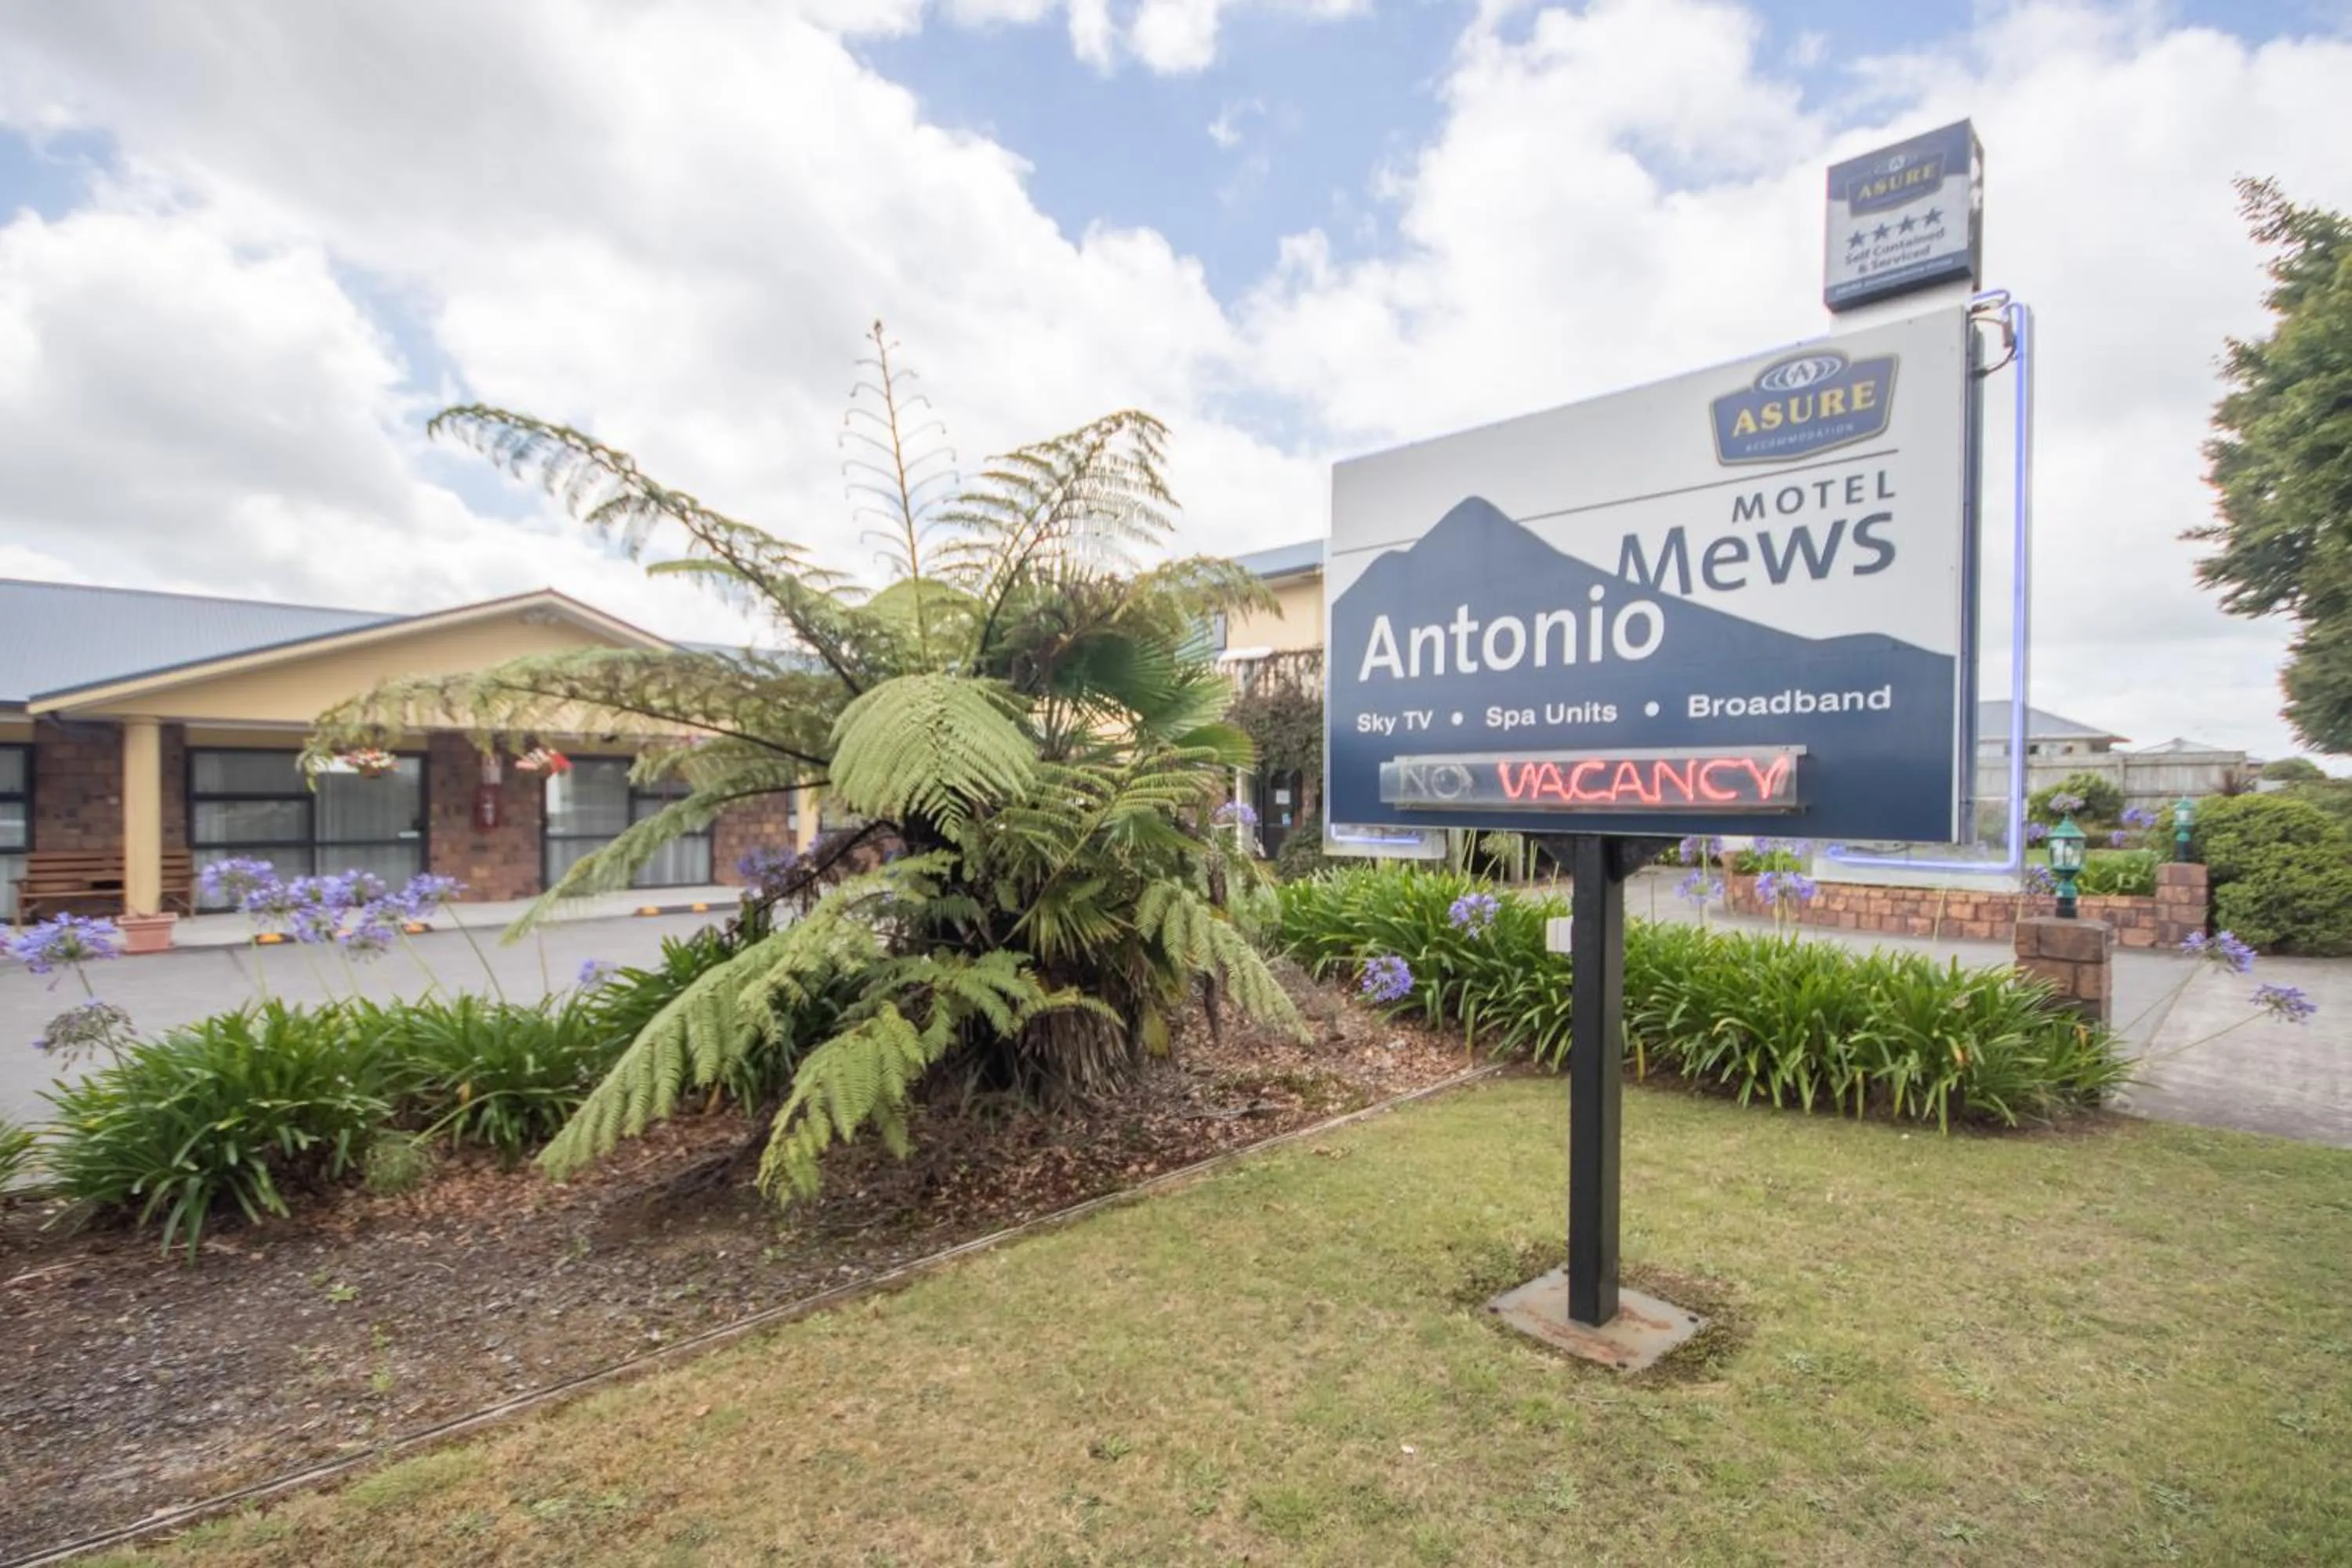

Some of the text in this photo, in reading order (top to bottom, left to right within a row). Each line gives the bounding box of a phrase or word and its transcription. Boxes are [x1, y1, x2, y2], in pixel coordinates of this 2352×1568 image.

[1859, 163, 1936, 200] ASURE
[1732, 380, 1876, 437] ASURE
[1731, 470, 1896, 523] MOTEL
[1617, 512, 1896, 596] Mews
[1359, 585, 1664, 682] Antonio
[1357, 684, 1891, 735] Sky TV Spa Units Broadband
[1400, 757, 1790, 802] NO VACANCY
